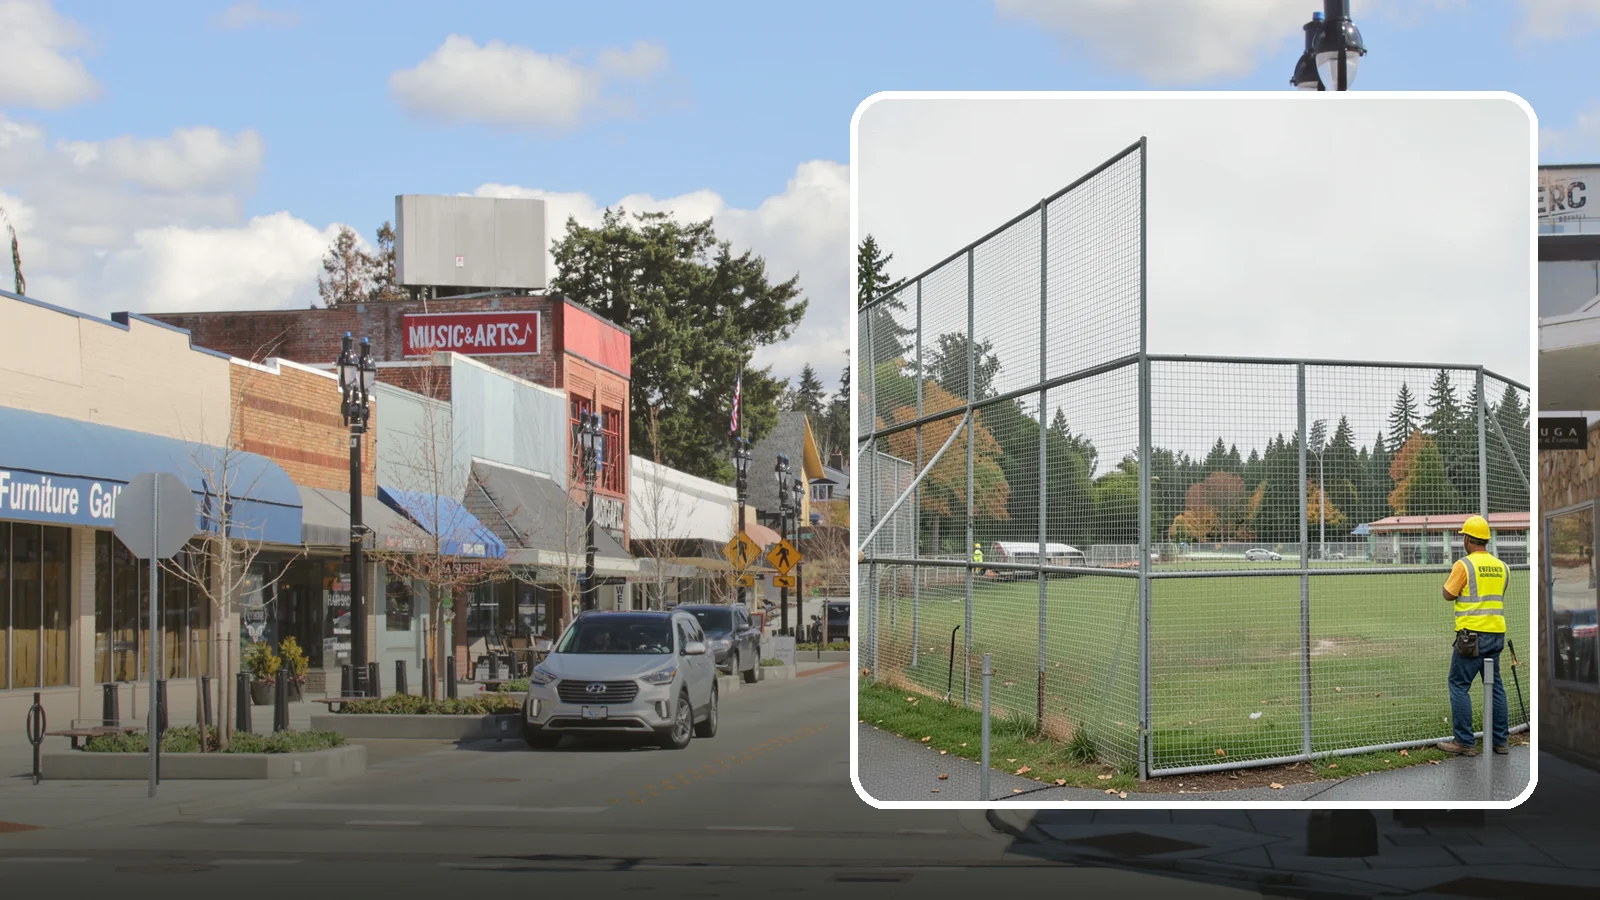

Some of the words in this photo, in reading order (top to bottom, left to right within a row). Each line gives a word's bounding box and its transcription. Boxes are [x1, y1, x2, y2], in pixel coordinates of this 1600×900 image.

[408, 322, 520, 349] MUSIC&ARTS
[0, 471, 79, 516] Furniture
[89, 482, 122, 520] Gal
[453, 563, 479, 574] SUSHI
